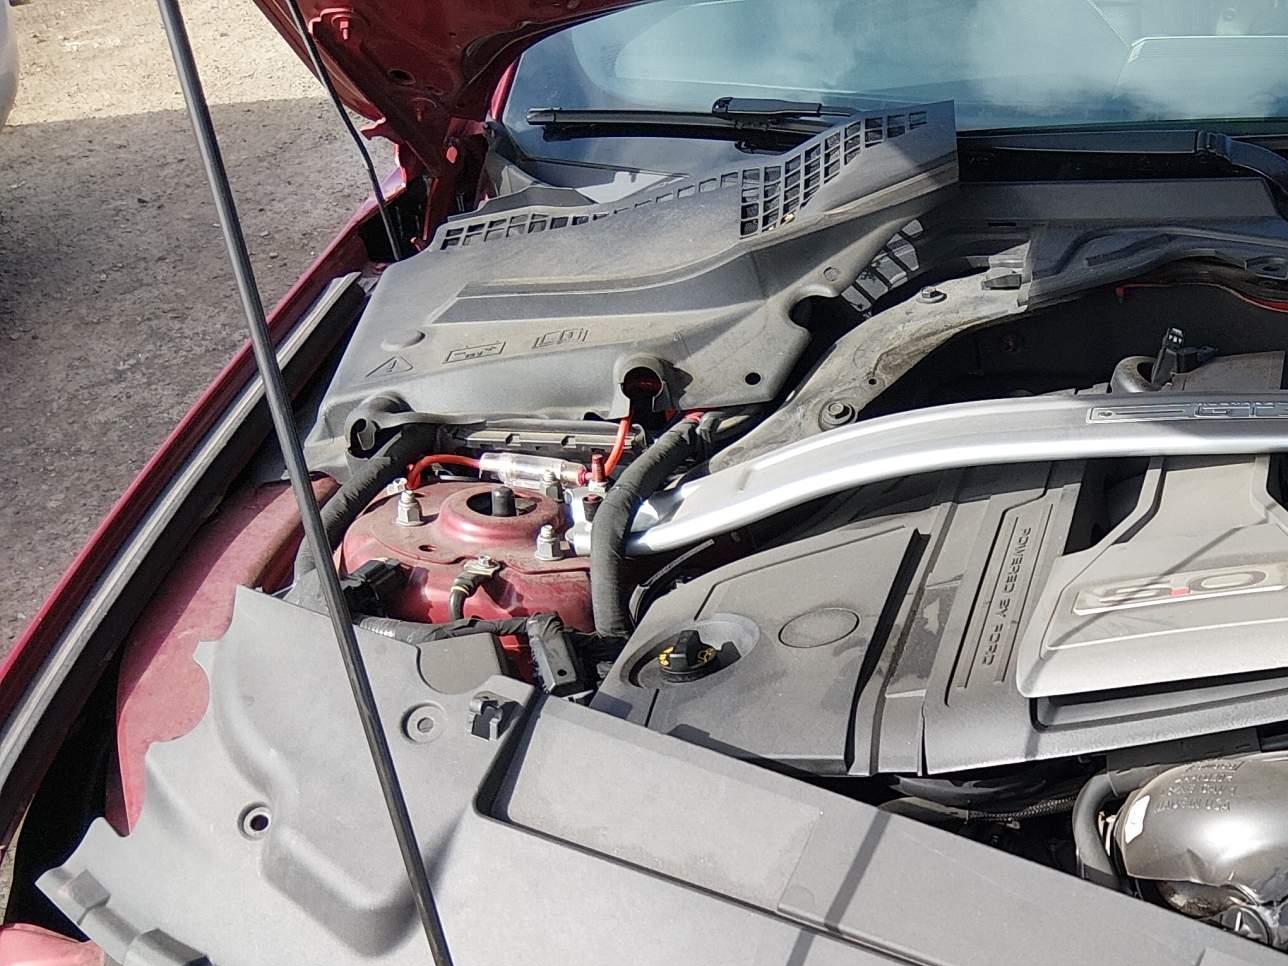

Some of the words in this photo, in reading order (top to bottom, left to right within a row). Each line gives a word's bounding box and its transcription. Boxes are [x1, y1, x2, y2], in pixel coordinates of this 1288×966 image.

[1003, 527, 1032, 593] POWERED
[995, 598, 1011, 618] BY
[981, 623, 1004, 666] FORD
